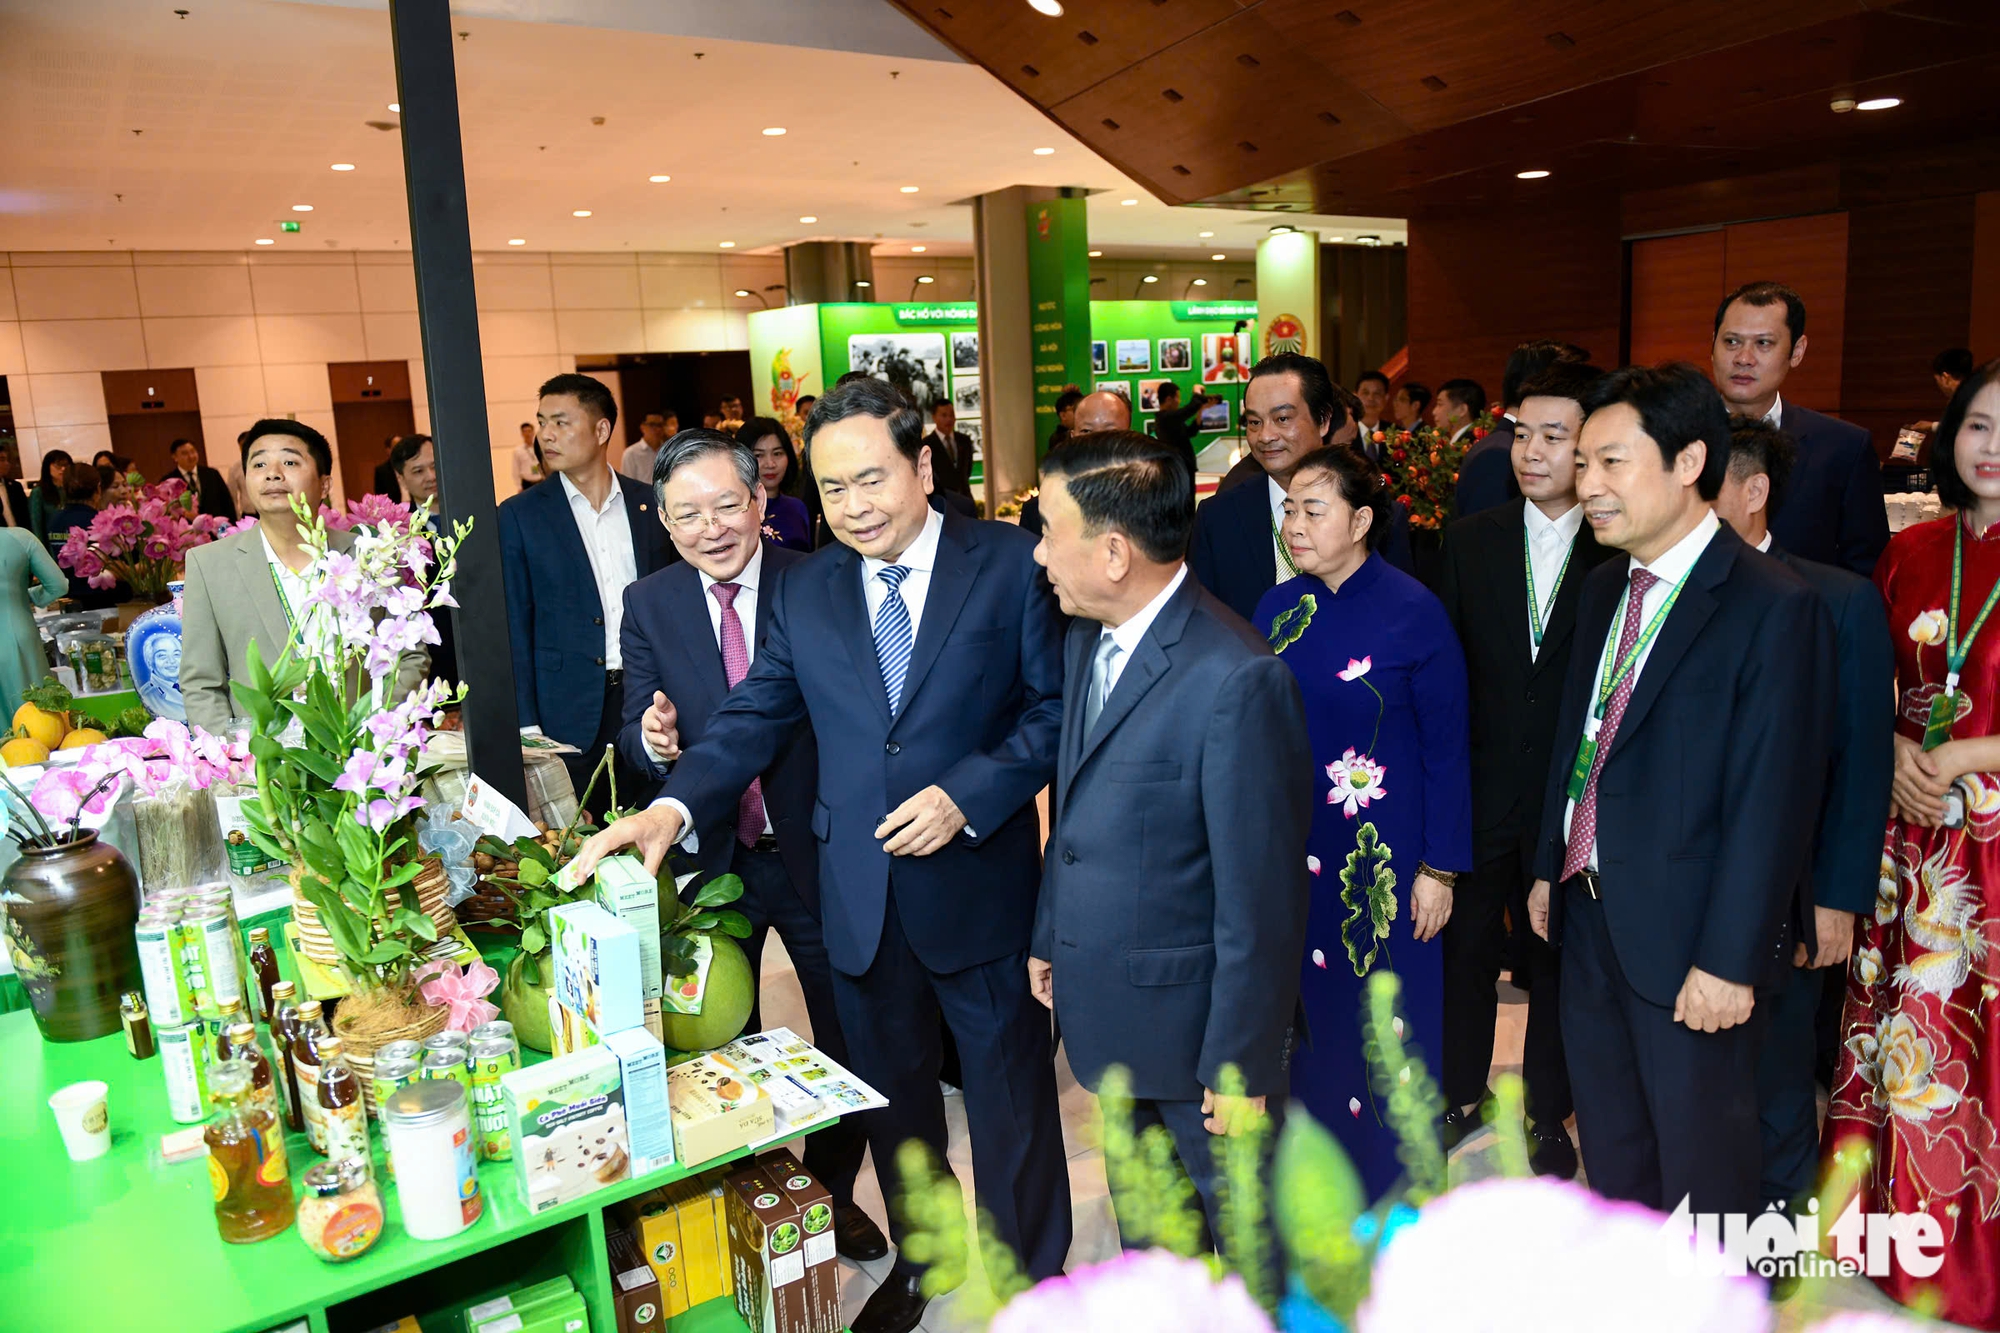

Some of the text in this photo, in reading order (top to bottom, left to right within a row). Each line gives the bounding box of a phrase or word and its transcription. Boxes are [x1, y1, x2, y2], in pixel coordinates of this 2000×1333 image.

[899, 308, 914, 319] BÁC
[916, 307, 929, 319] HỒ
[945, 307, 967, 318] NÔNG
[1624, 654, 1634, 667] TOÀN
[620, 888, 653, 901] MEET MORE
[643, 1052, 659, 1061] MORE
[548, 1073, 590, 1095] MEET MORE
